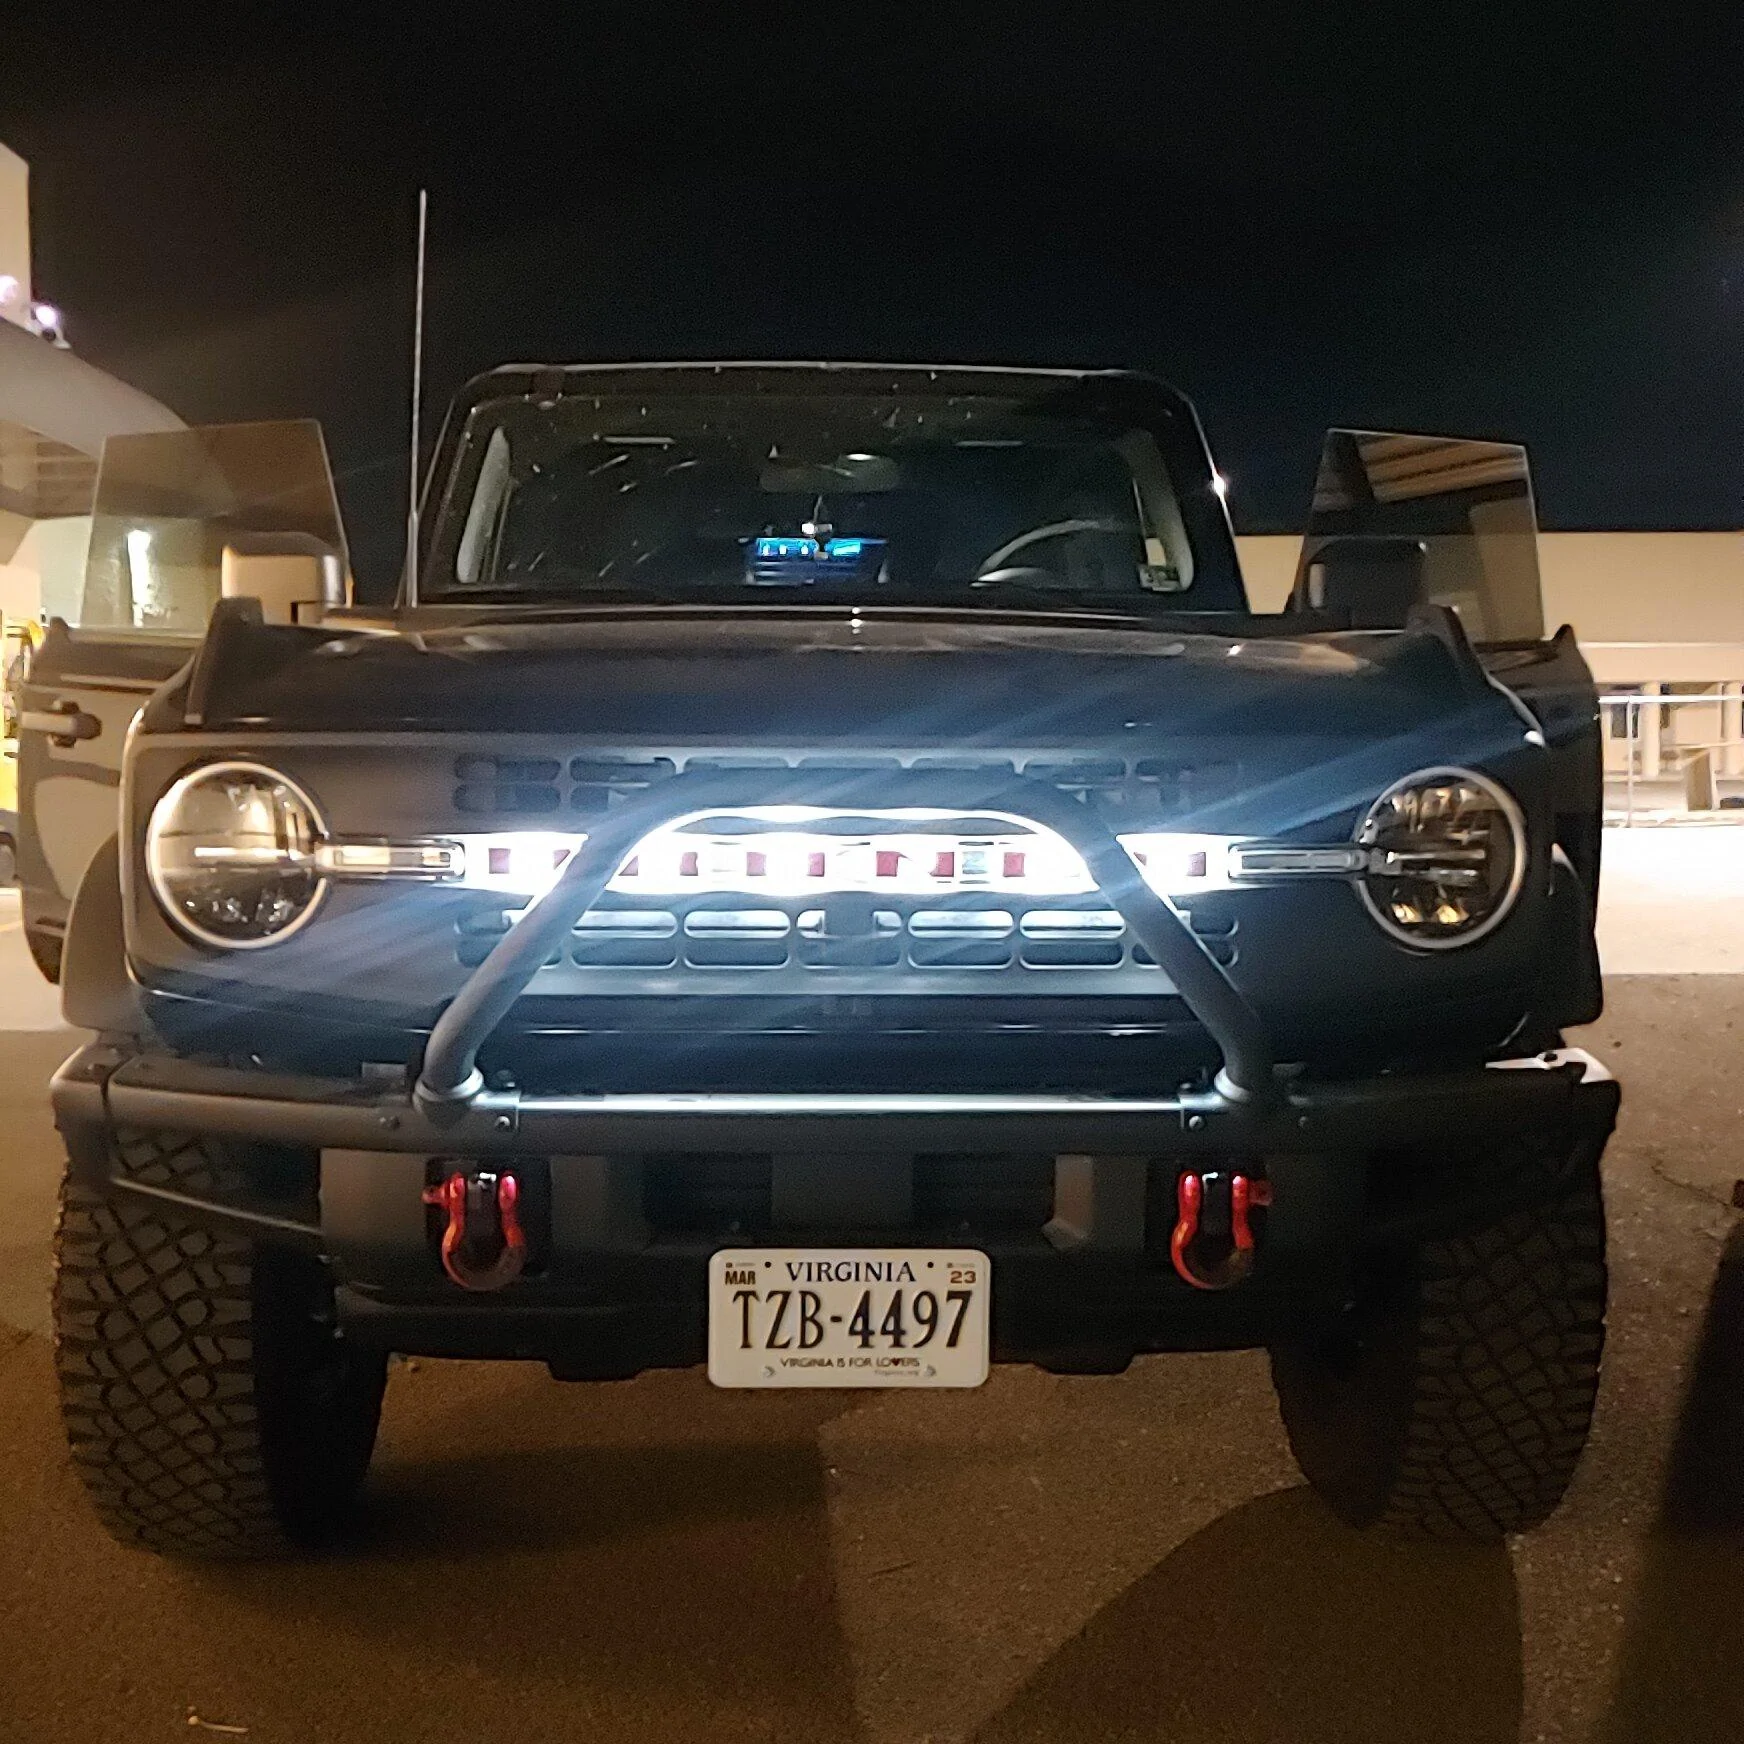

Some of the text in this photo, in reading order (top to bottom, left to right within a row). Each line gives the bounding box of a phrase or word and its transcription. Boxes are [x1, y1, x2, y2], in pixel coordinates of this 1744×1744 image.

[725, 1271, 756, 1285] MAR
[785, 1262, 916, 1283] VIRGINIA
[950, 1271, 976, 1284] 23
[732, 1289, 974, 1350] TZB-4497
[780, 1357, 833, 1368] VIRGINIA
[837, 1357, 845, 1368] IS
[849, 1357, 872, 1368] FOR
